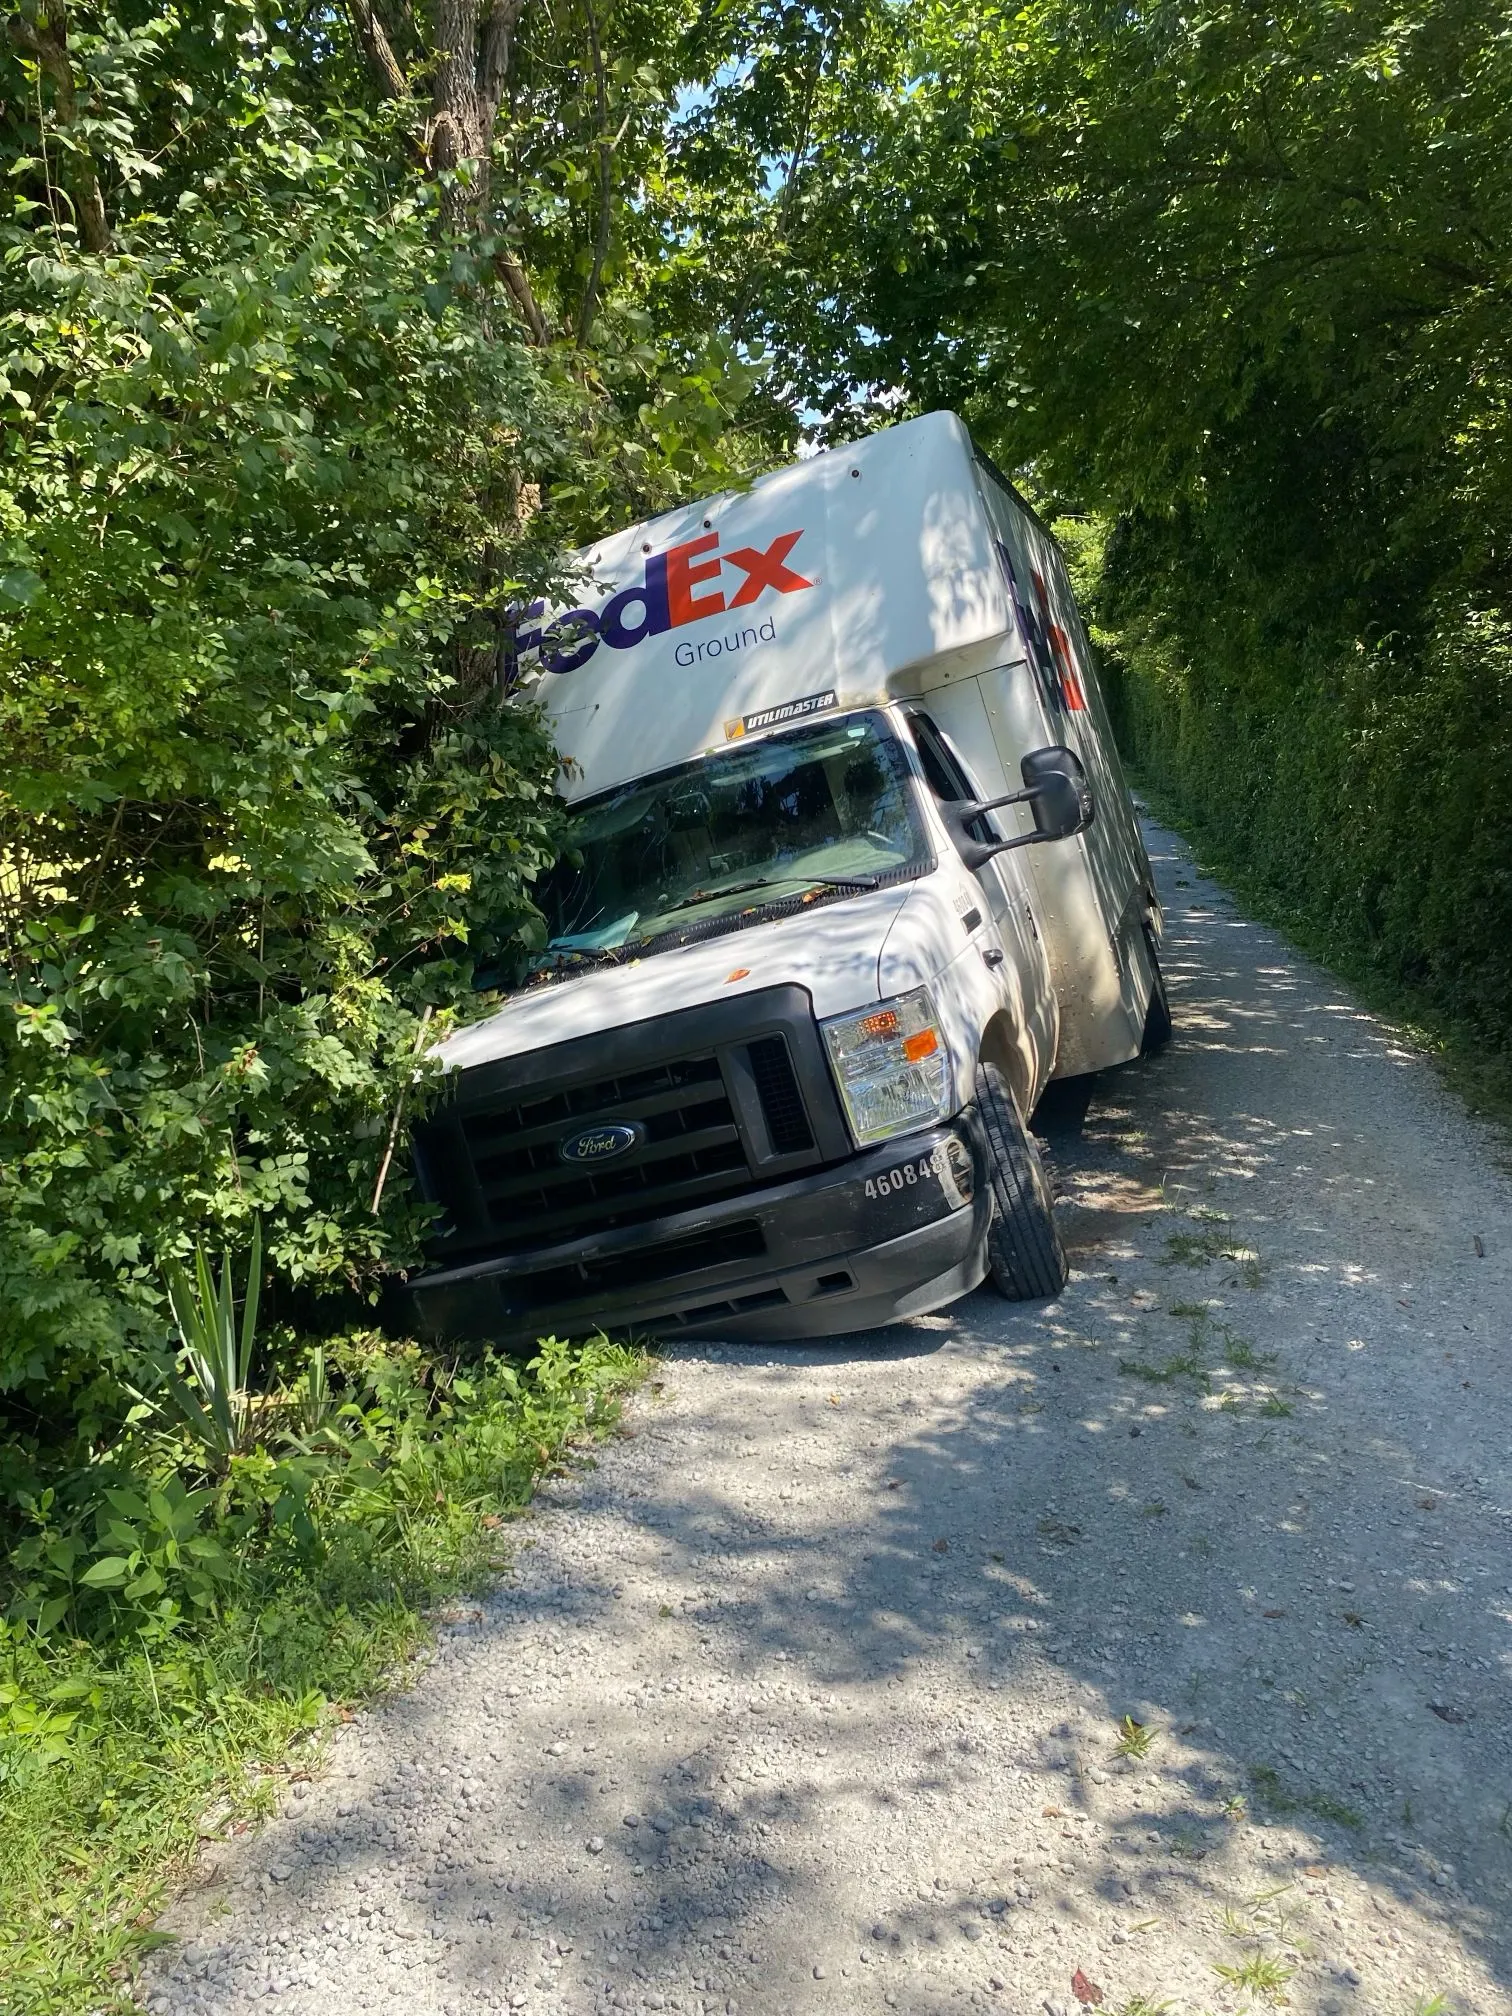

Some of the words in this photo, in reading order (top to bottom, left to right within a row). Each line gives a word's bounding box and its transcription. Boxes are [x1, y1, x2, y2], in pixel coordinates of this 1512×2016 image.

[674, 617, 776, 667] Ground
[577, 1133, 617, 1157] Ford
[864, 1154, 944, 1200] 460848
